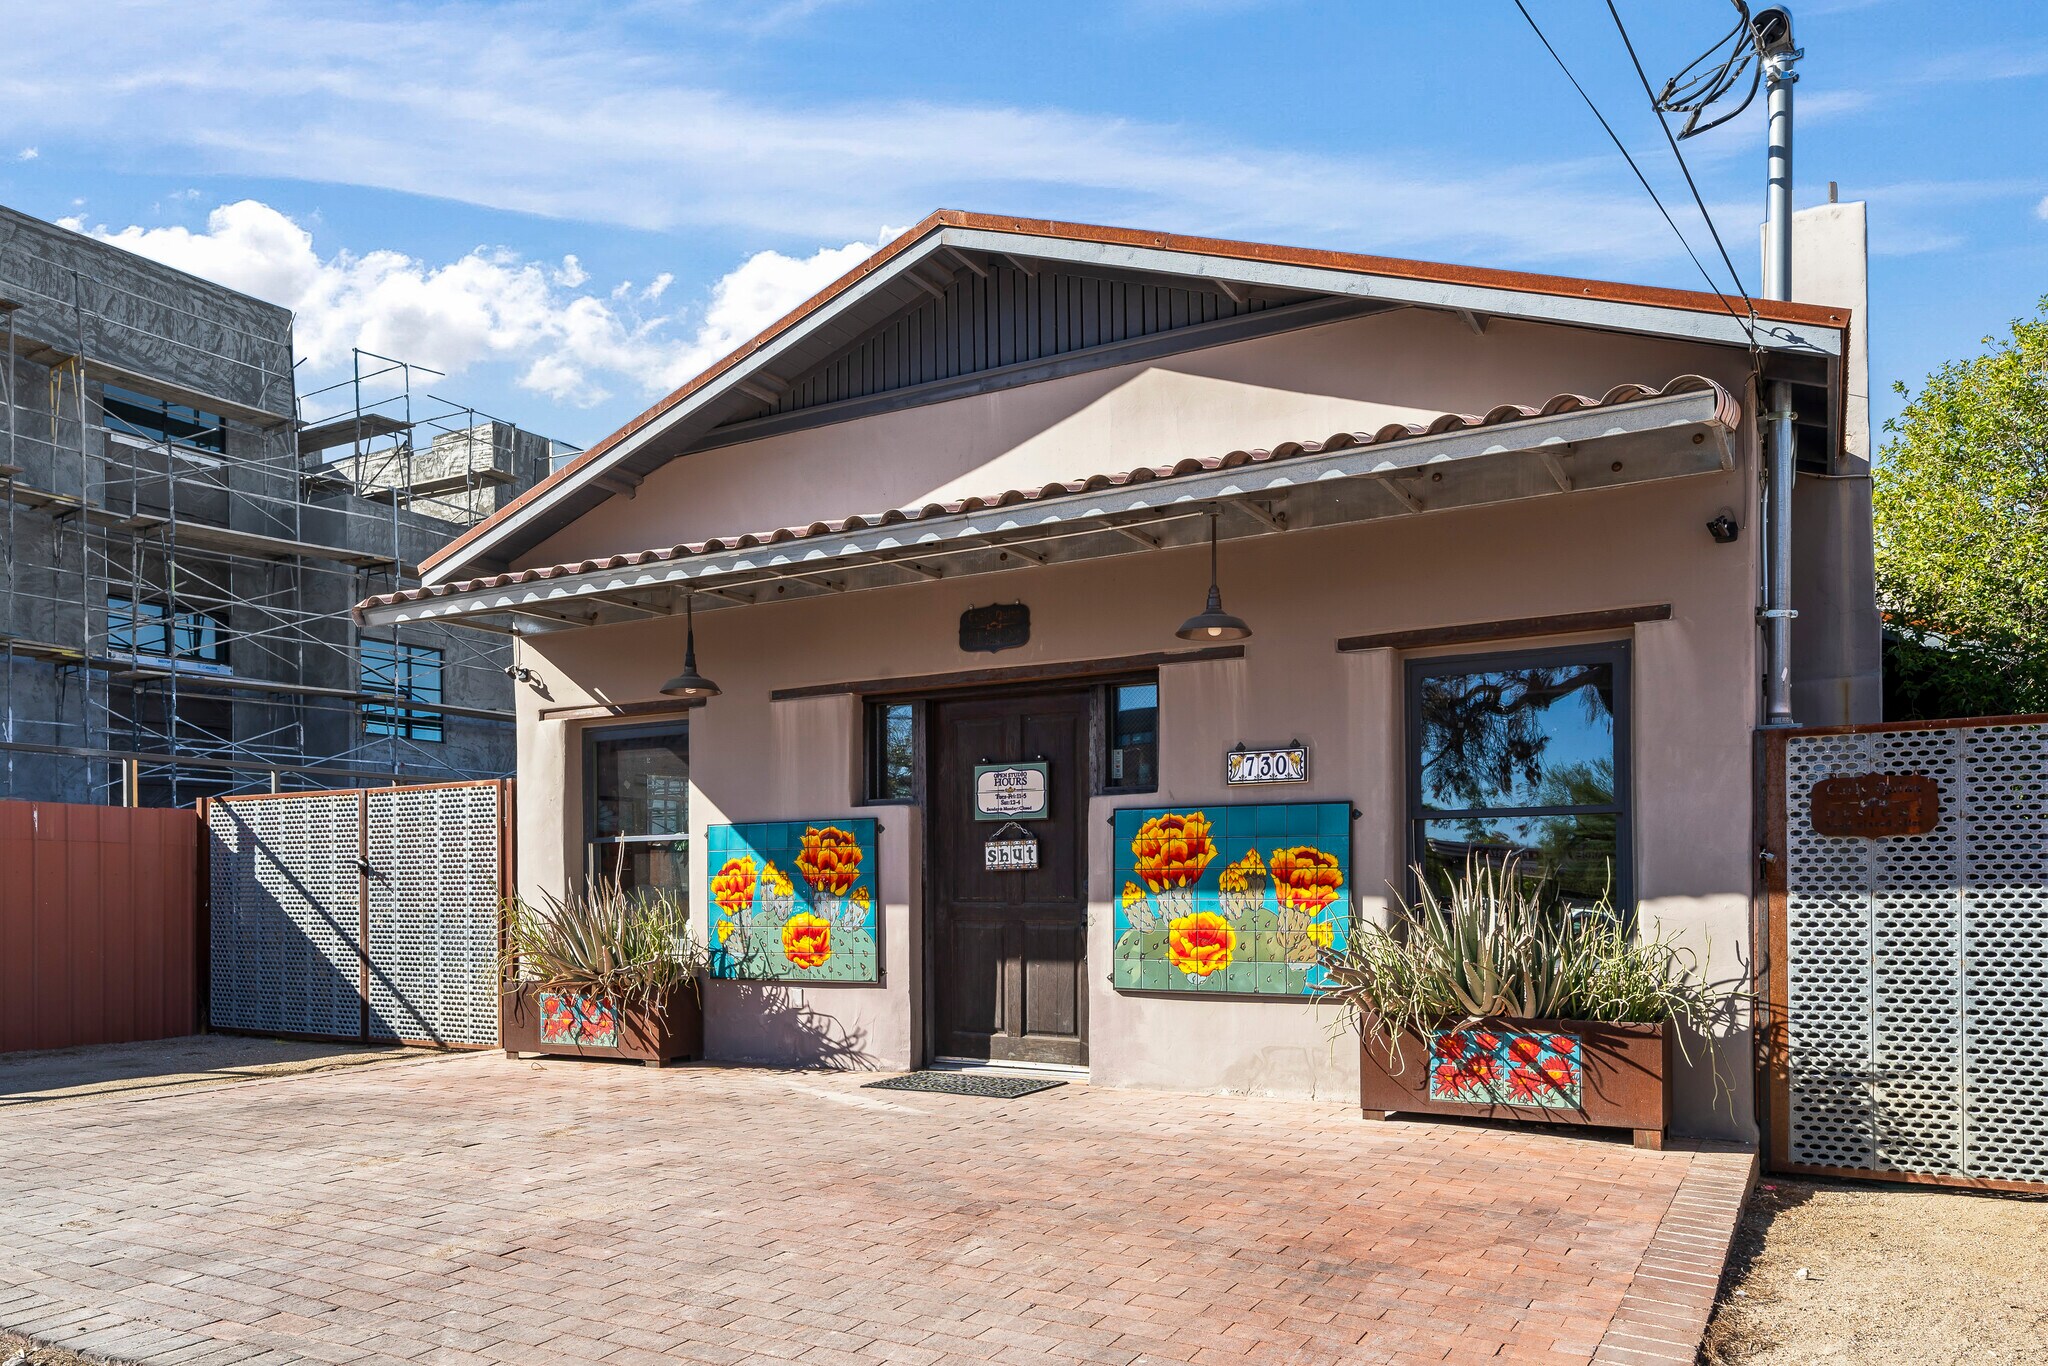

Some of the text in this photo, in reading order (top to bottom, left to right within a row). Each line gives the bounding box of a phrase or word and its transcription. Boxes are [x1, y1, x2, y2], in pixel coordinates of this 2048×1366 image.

[1245, 755, 1287, 776] 730
[994, 777, 1027, 786] HOURS
[987, 846, 1033, 863] shut
